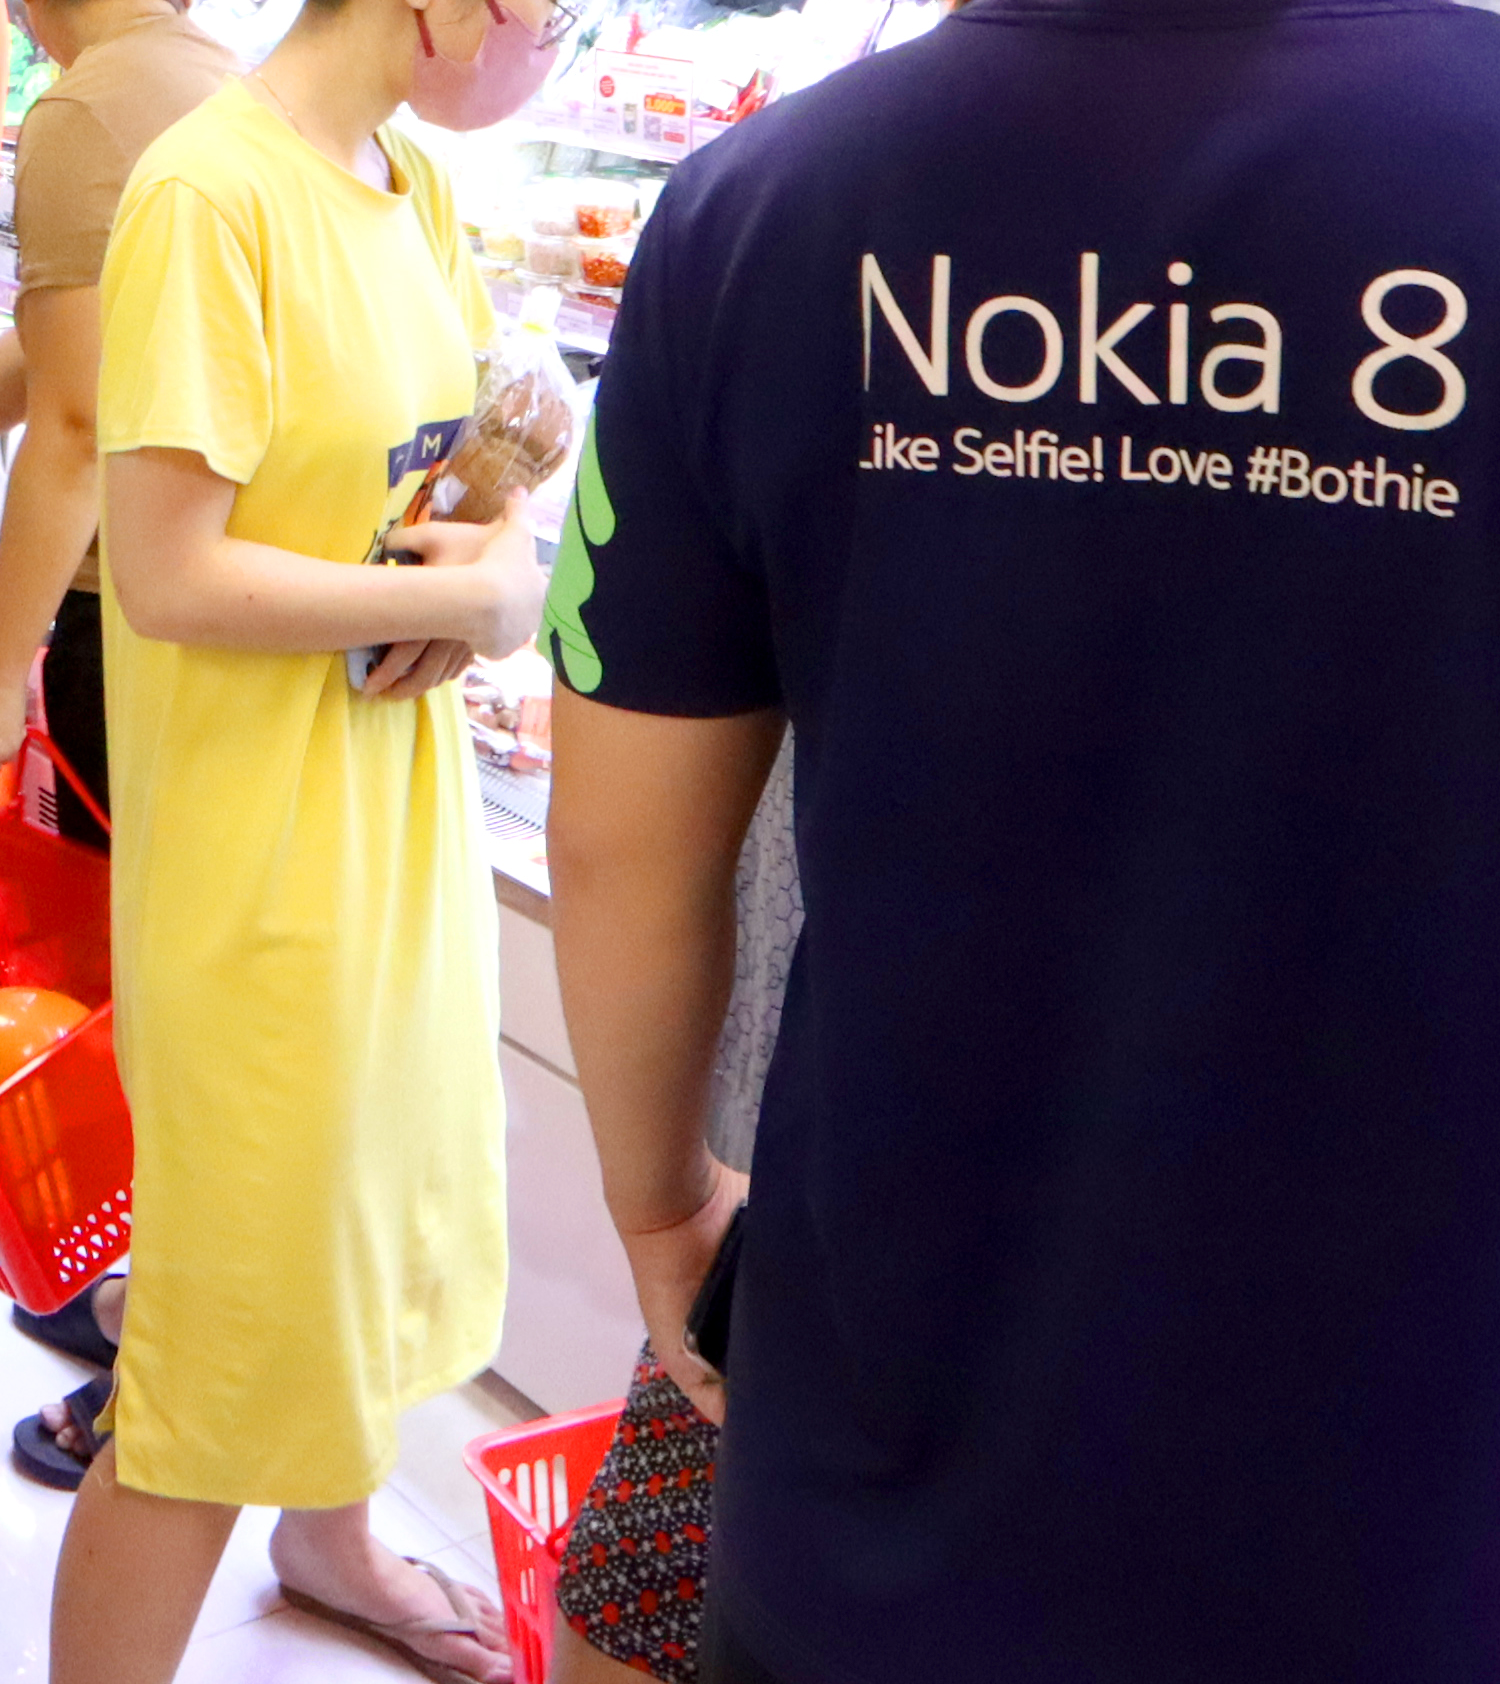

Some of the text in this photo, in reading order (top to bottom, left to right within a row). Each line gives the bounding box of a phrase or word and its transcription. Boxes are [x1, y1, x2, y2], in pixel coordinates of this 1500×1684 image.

[860, 252, 1468, 432] Nokia 8
[951, 427, 1105, 483] Selfie!
[1120, 434, 1233, 491] Love
[1245, 444, 1461, 520] #Bothie
